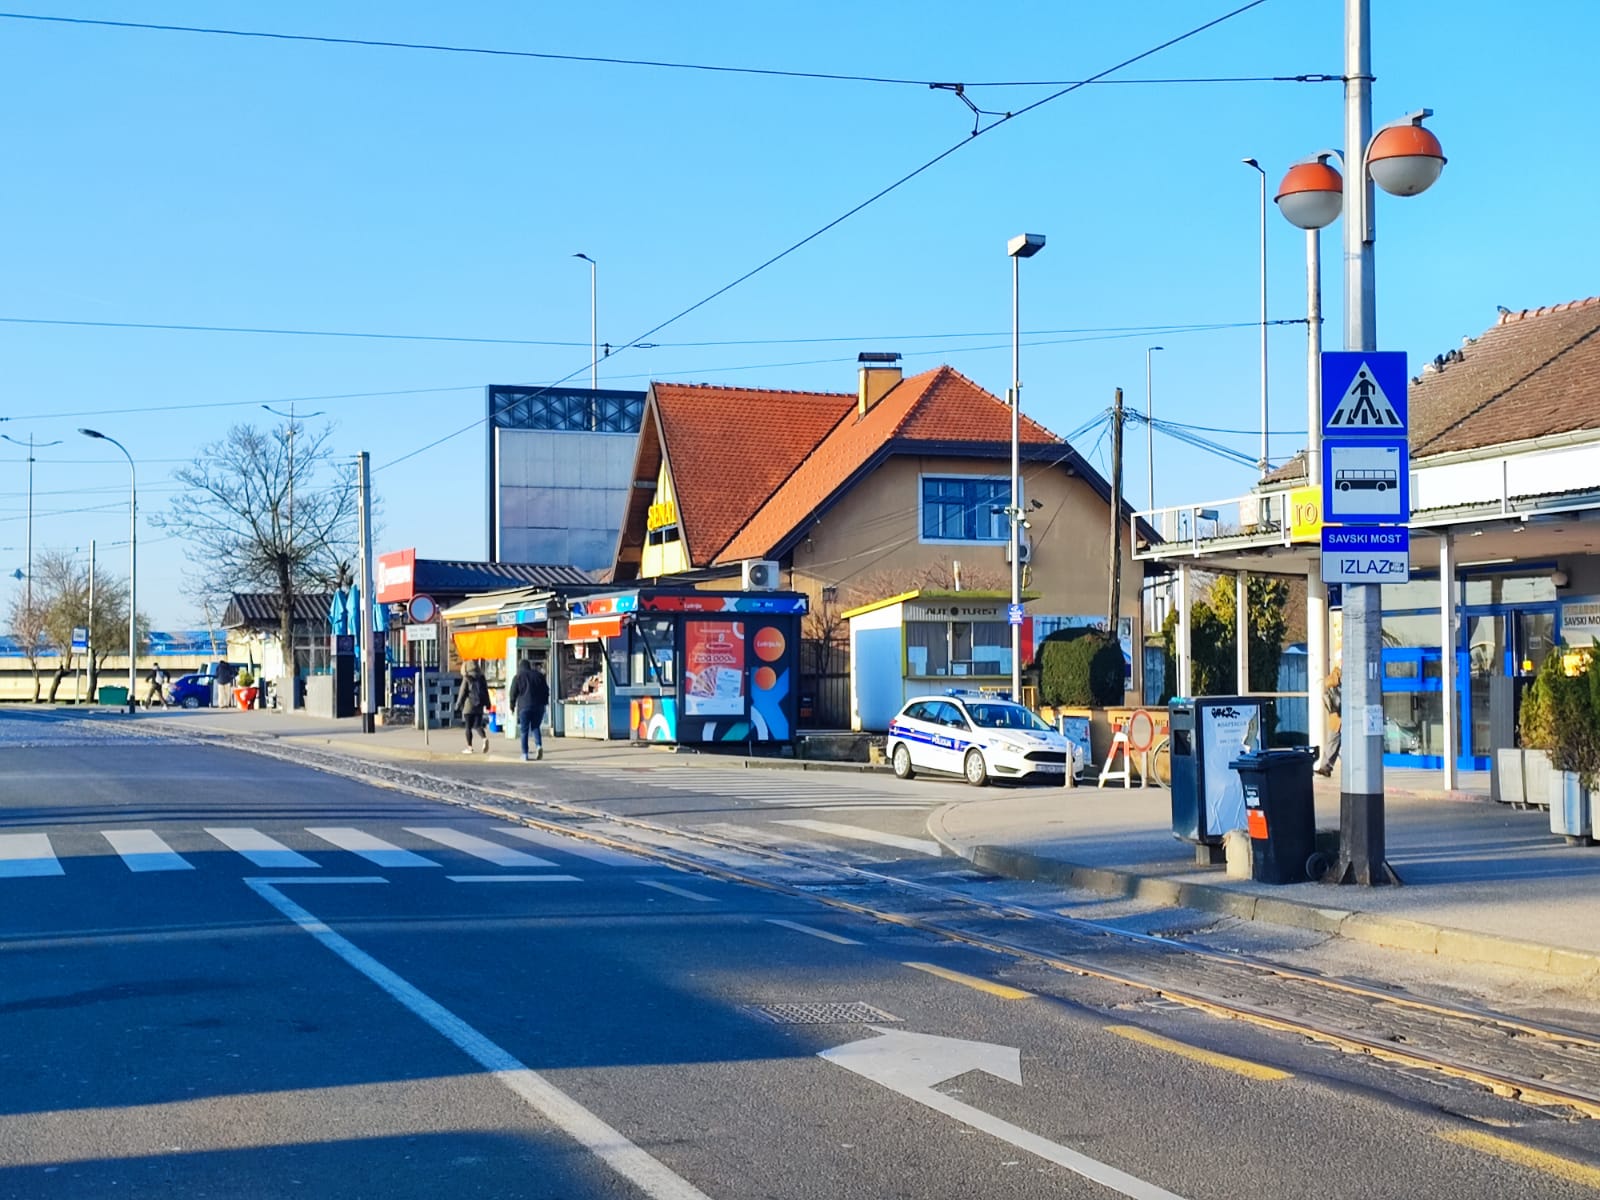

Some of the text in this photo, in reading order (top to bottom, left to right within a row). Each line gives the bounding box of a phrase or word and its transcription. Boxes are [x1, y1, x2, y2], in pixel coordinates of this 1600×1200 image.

[1328, 534, 1402, 544] SAVSKI MOST
[1340, 559, 1390, 574] IZLAZ
[962, 607, 999, 616] TURIST
[1564, 616, 1587, 626] SAVSKI
